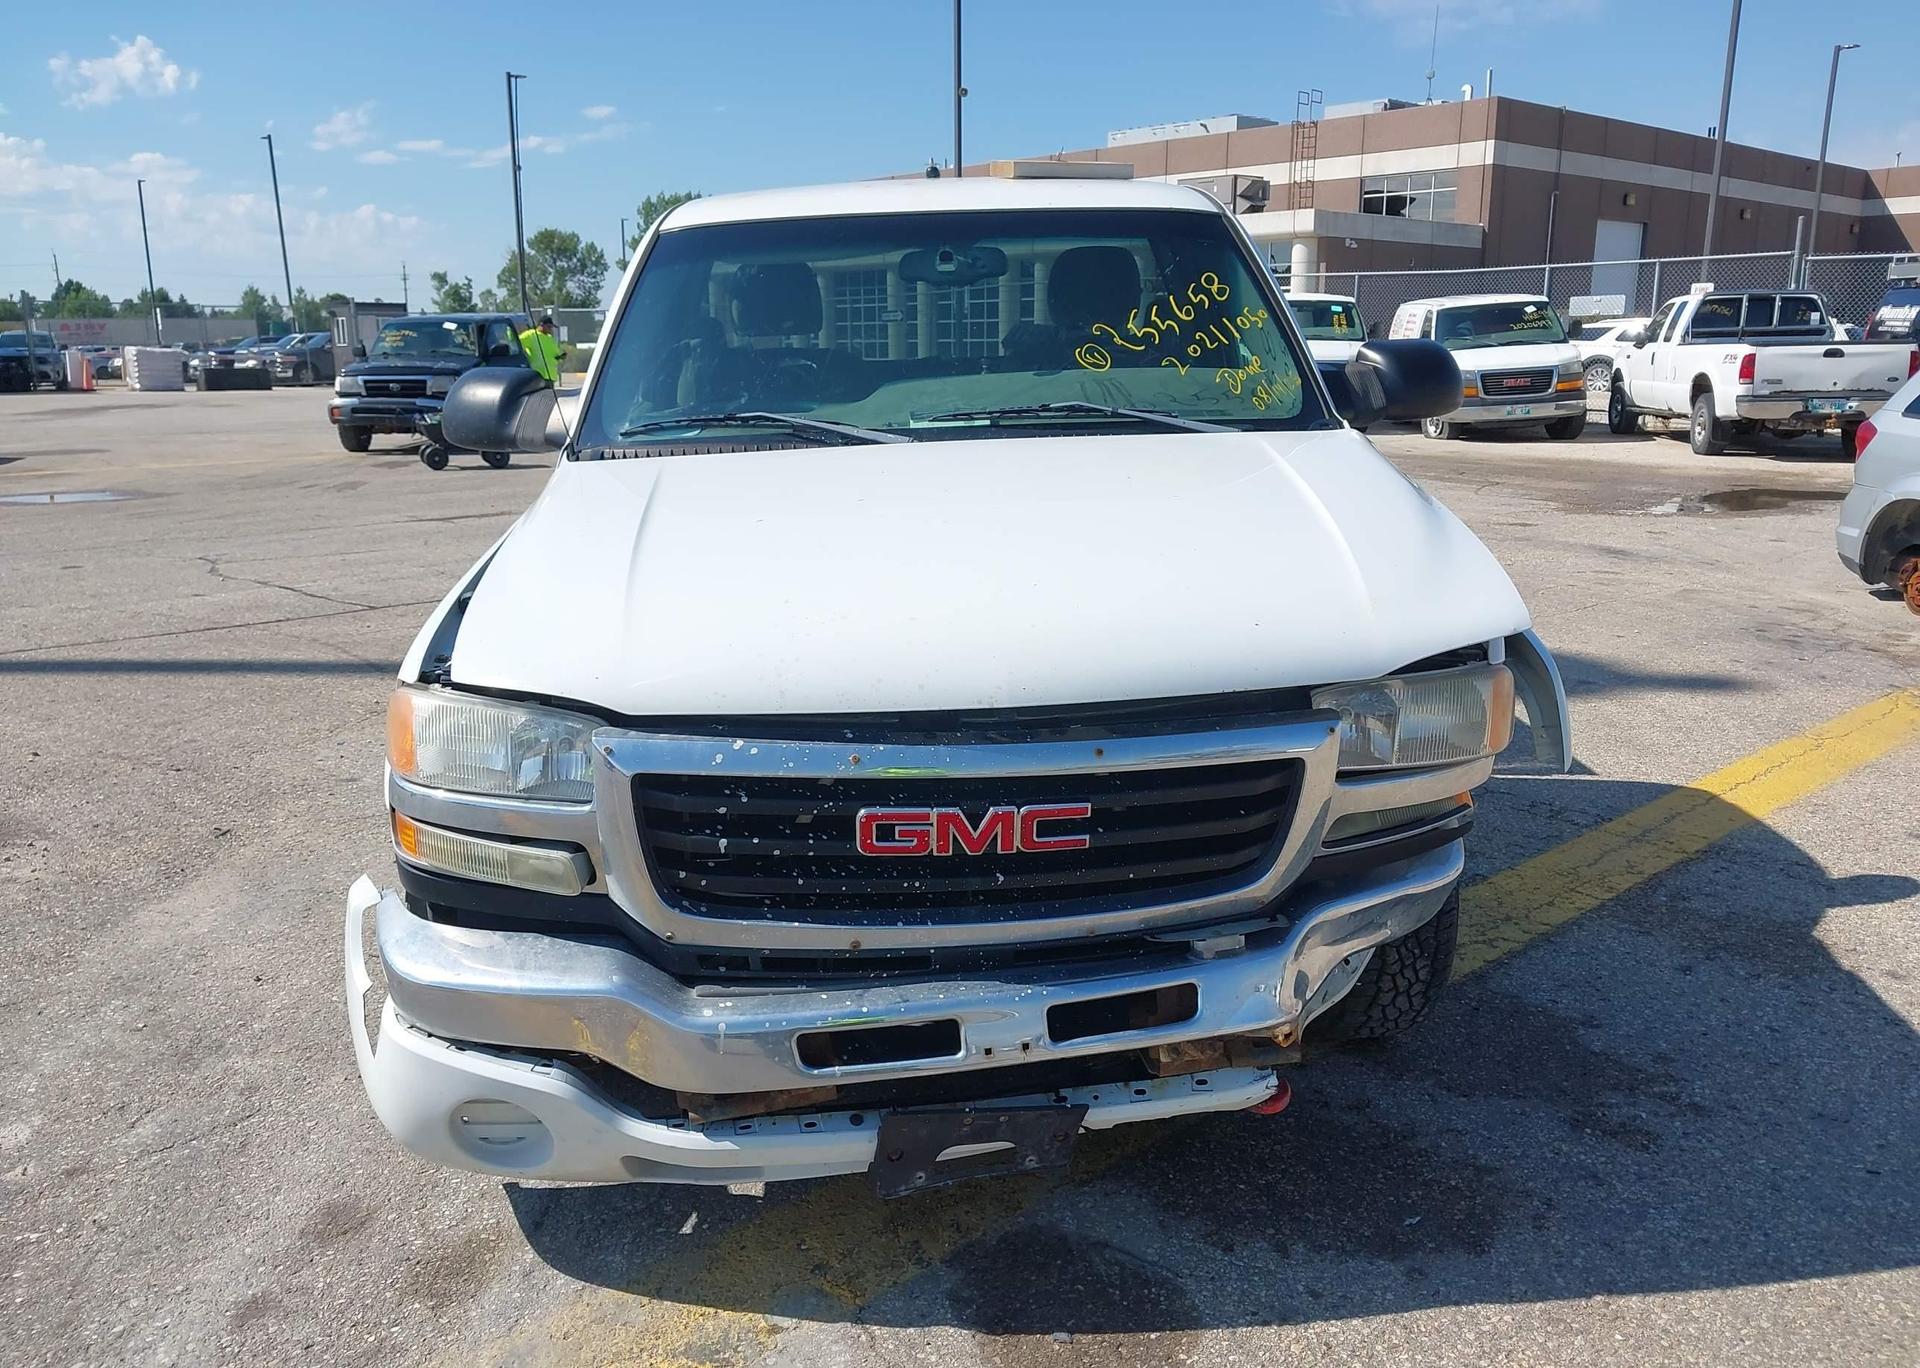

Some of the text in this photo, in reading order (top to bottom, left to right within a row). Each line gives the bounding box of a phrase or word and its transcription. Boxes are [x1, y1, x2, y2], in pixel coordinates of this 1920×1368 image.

[1092, 272, 1230, 350] 255658
[1216, 355, 1267, 395] Done
[856, 802, 1092, 857] GMC
